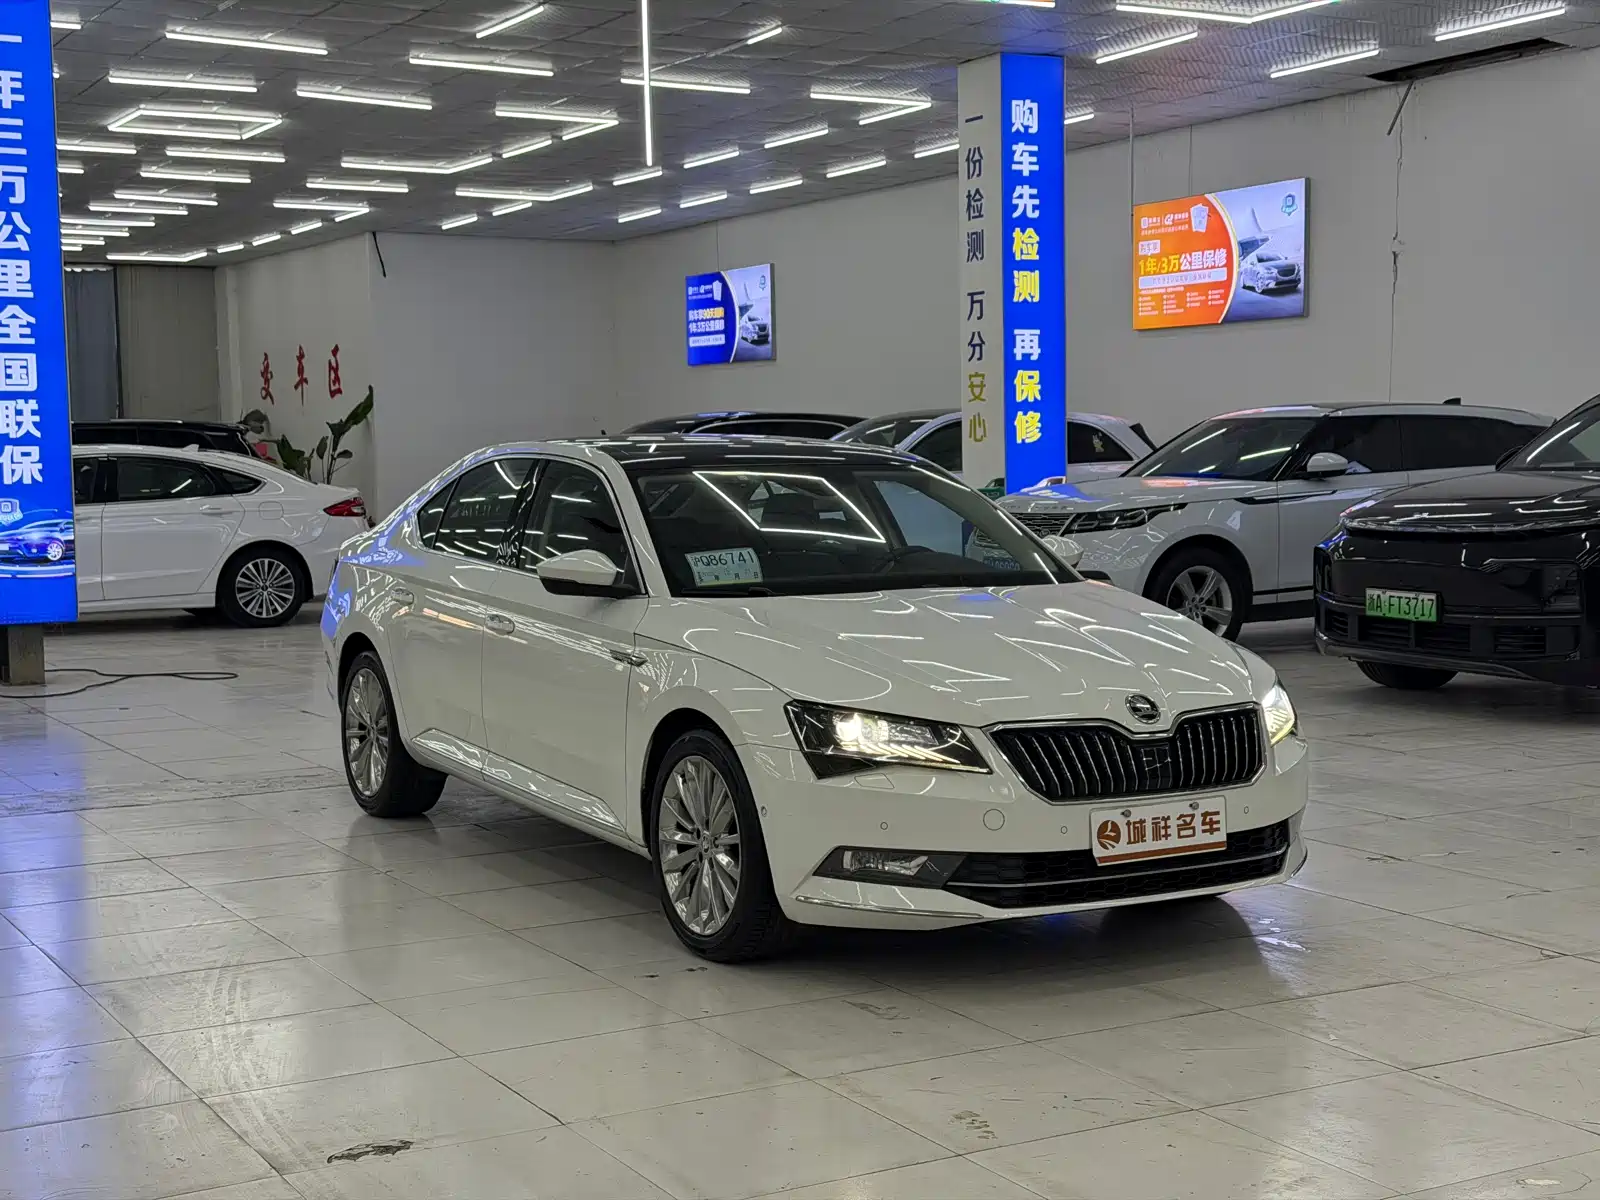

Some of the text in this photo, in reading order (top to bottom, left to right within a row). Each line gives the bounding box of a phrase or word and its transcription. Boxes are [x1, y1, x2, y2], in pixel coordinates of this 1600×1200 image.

[965, 114, 987, 443] 一份检测 万分安心
[1011, 99, 1042, 444] 购车先检测 再保修
[1125, 810, 1221, 846] 城祥名车
